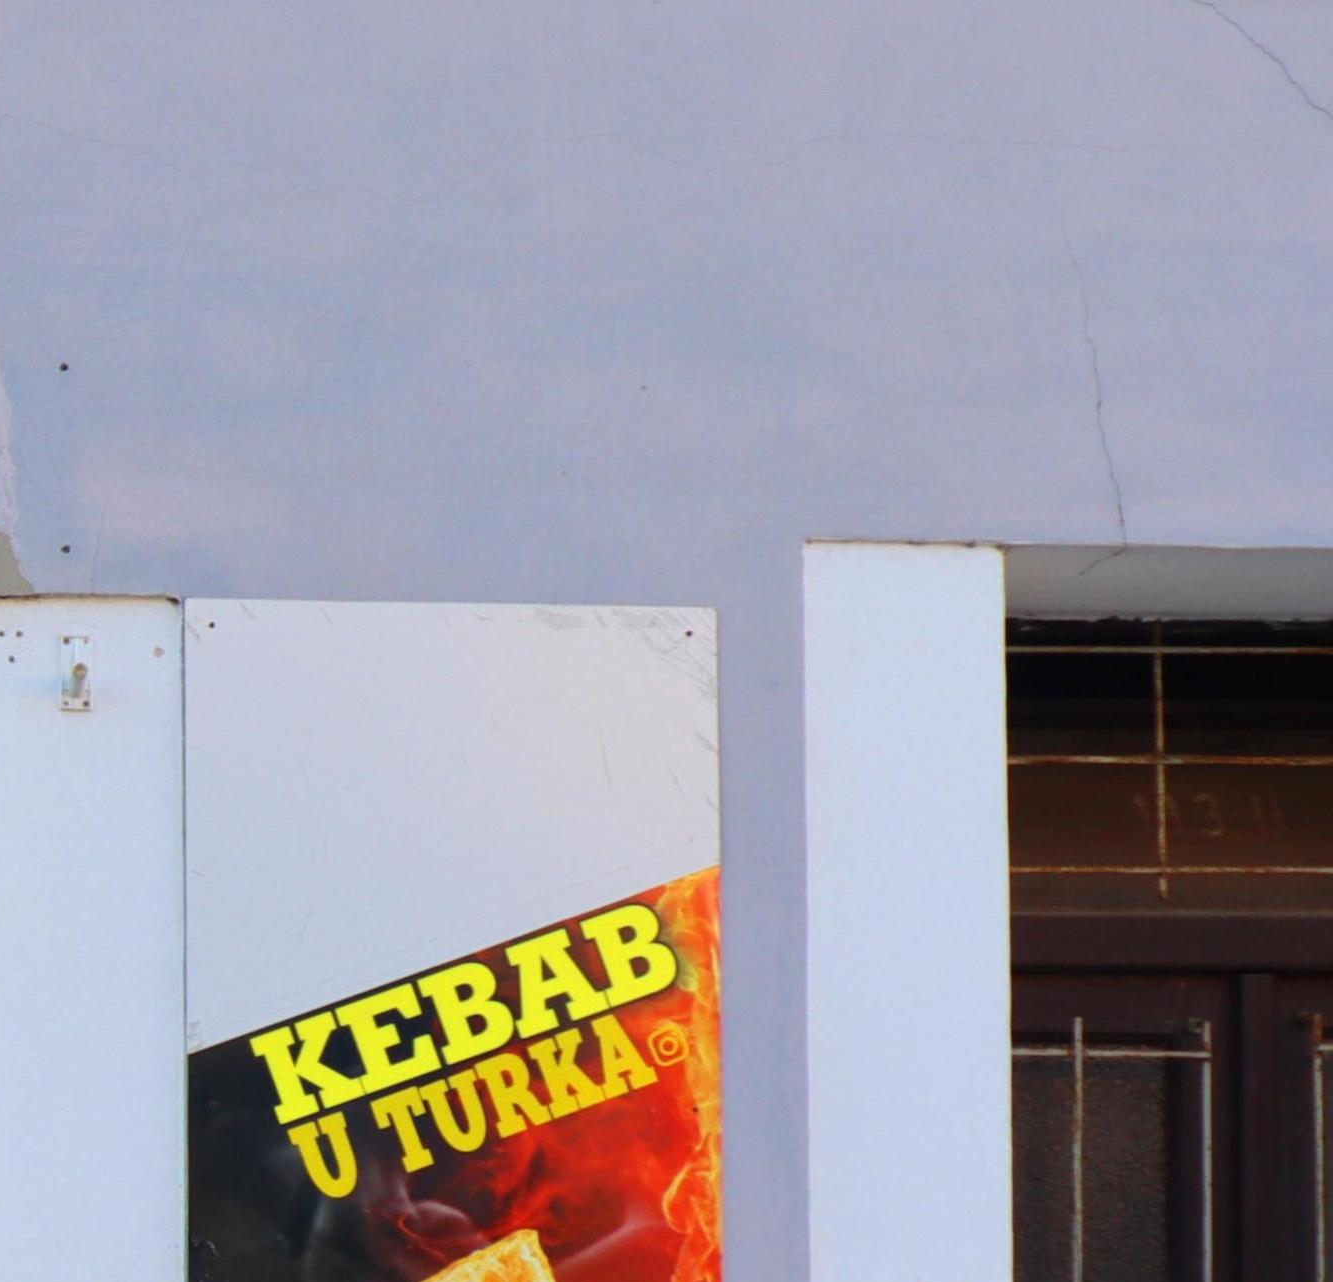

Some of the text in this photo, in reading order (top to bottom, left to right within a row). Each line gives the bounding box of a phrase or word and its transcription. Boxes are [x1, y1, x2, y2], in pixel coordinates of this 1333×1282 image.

[250, 904, 678, 1125] KEBAB
[287, 1014, 659, 1199] U TURKA
